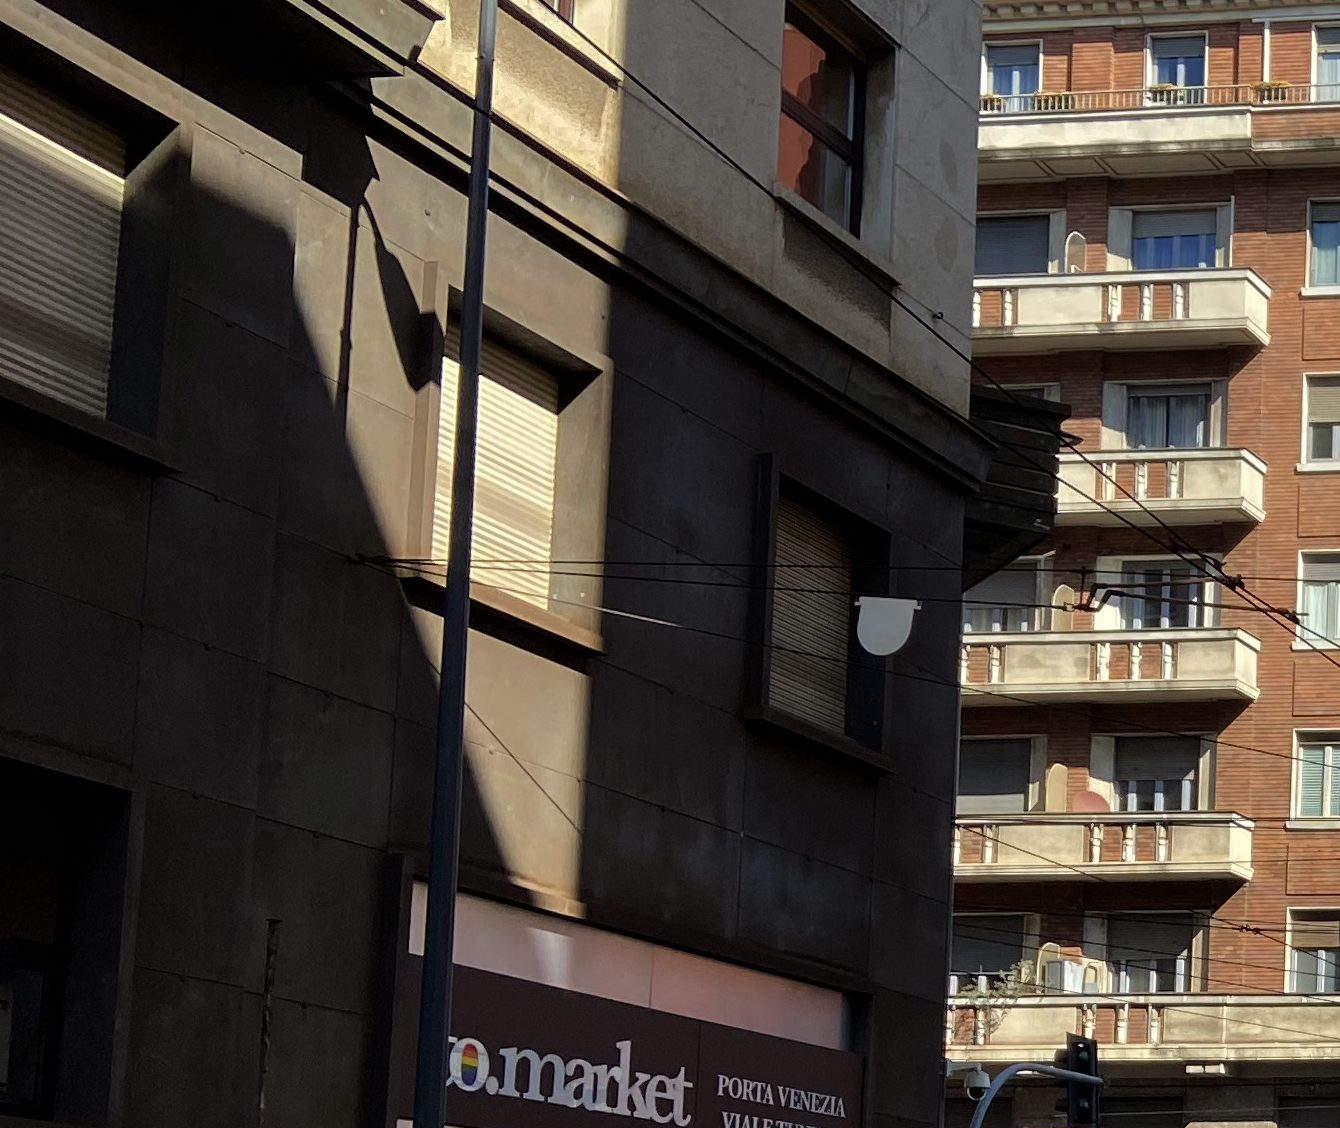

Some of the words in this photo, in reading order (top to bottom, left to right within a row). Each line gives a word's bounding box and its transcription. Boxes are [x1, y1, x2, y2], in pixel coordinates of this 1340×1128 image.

[446, 1034, 693, 1128] o.market
[716, 1074, 774, 1106] PORTA
[777, 1086, 846, 1118] VENEZIA
